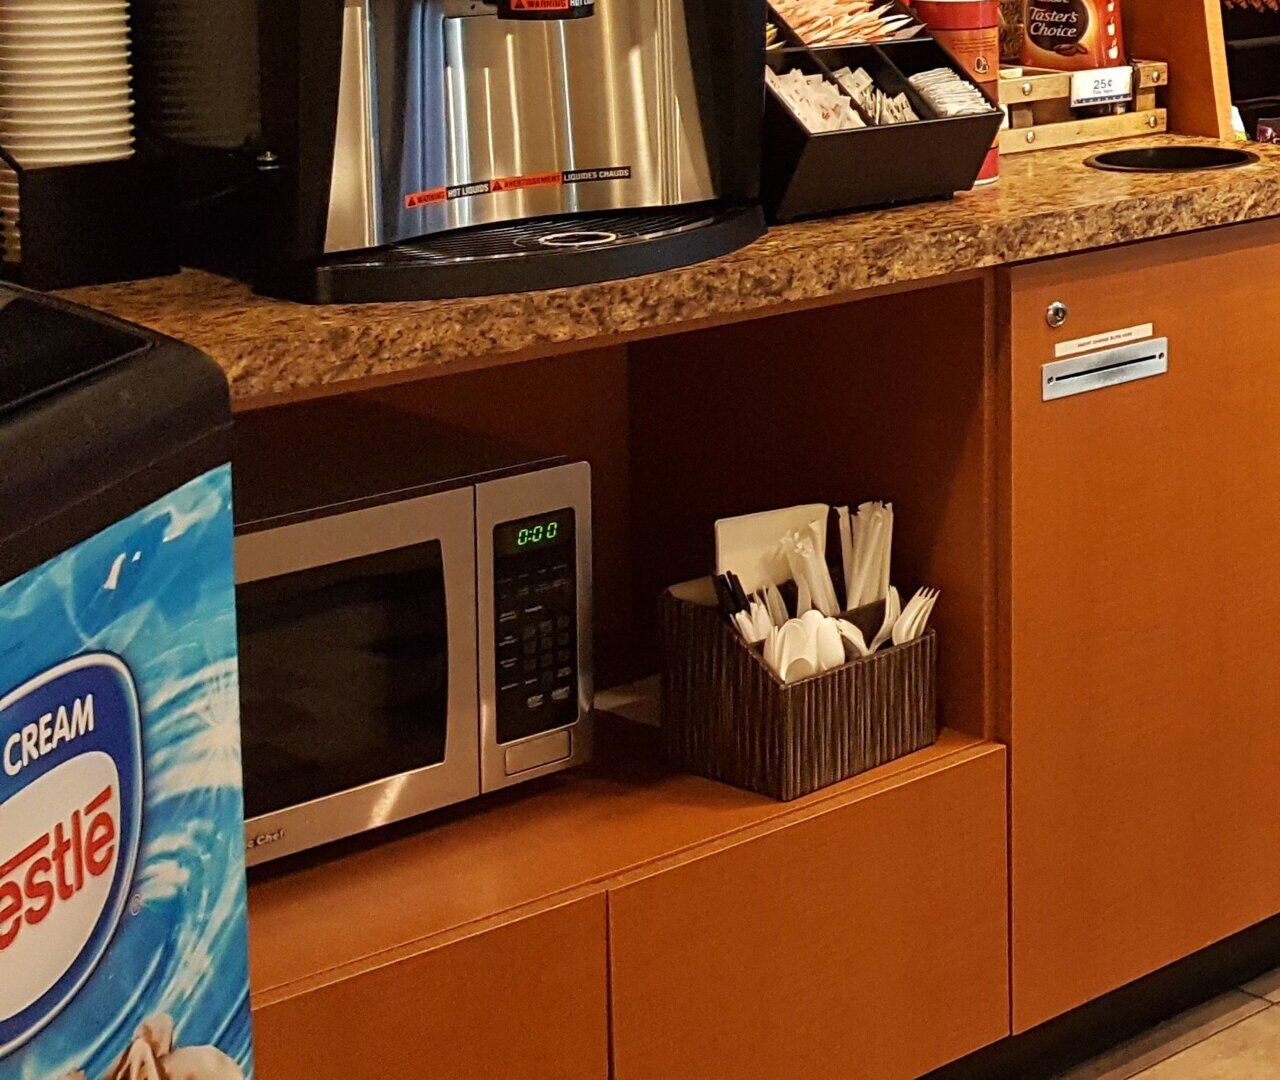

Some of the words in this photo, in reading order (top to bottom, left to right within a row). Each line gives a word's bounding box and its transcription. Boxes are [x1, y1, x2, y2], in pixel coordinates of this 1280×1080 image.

[1029, 6, 1079, 24] Taster's
[1029, 22, 1078, 38] Choice
[1093, 78, 1113, 90] 25¢
[447, 188, 462, 198] HOT
[462, 185, 490, 196] LIQUIDS
[3, 693, 95, 777] CREAM
[256, 829, 286, 848] Chef
